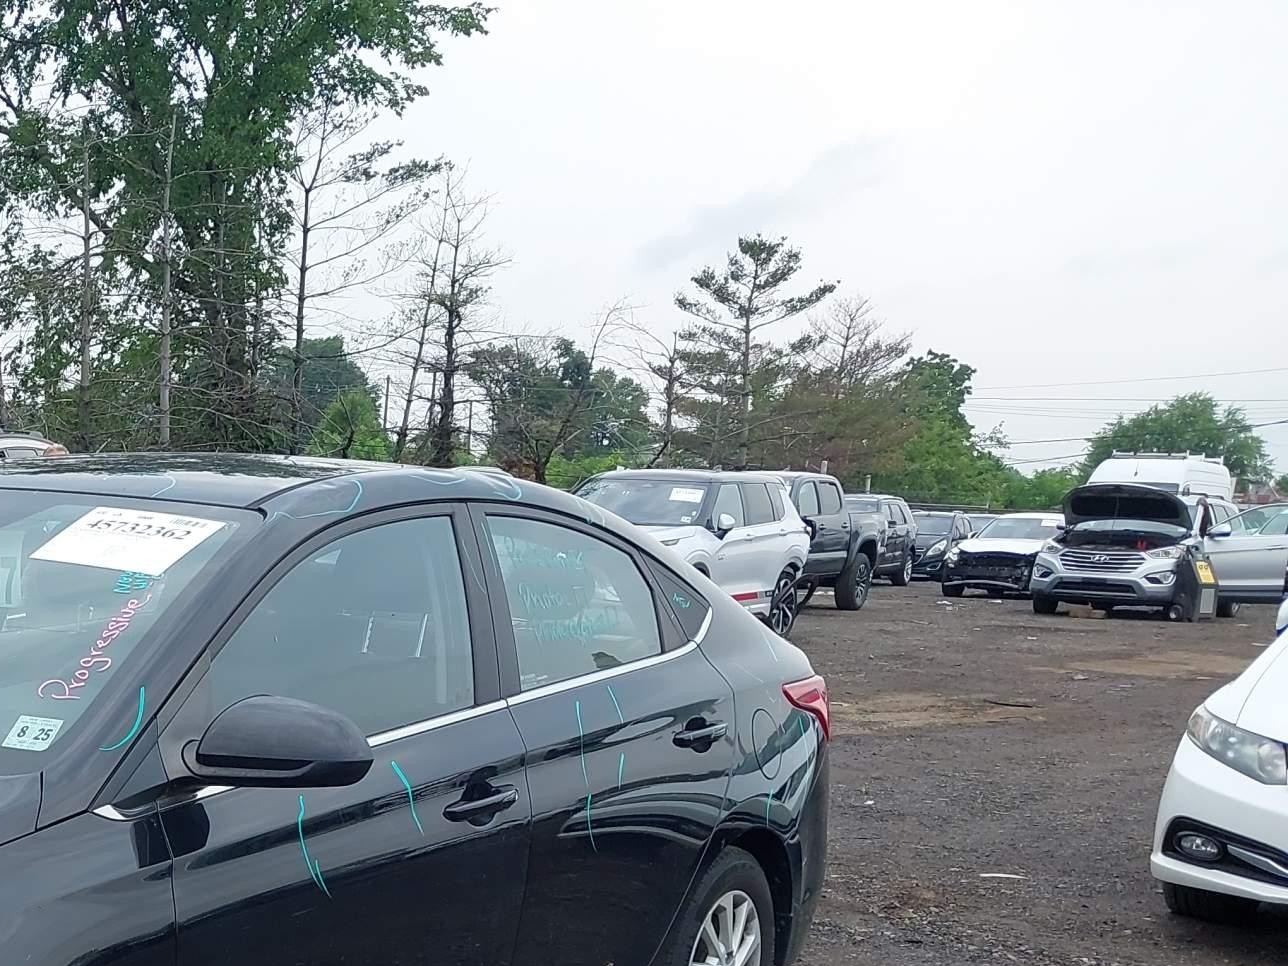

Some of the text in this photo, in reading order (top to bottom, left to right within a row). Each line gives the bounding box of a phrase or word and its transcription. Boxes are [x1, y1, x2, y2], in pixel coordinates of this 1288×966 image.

[88, 519, 192, 540] 45732362
[38, 593, 152, 699] Progressive
[17, 726, 54, 741] 8 25
